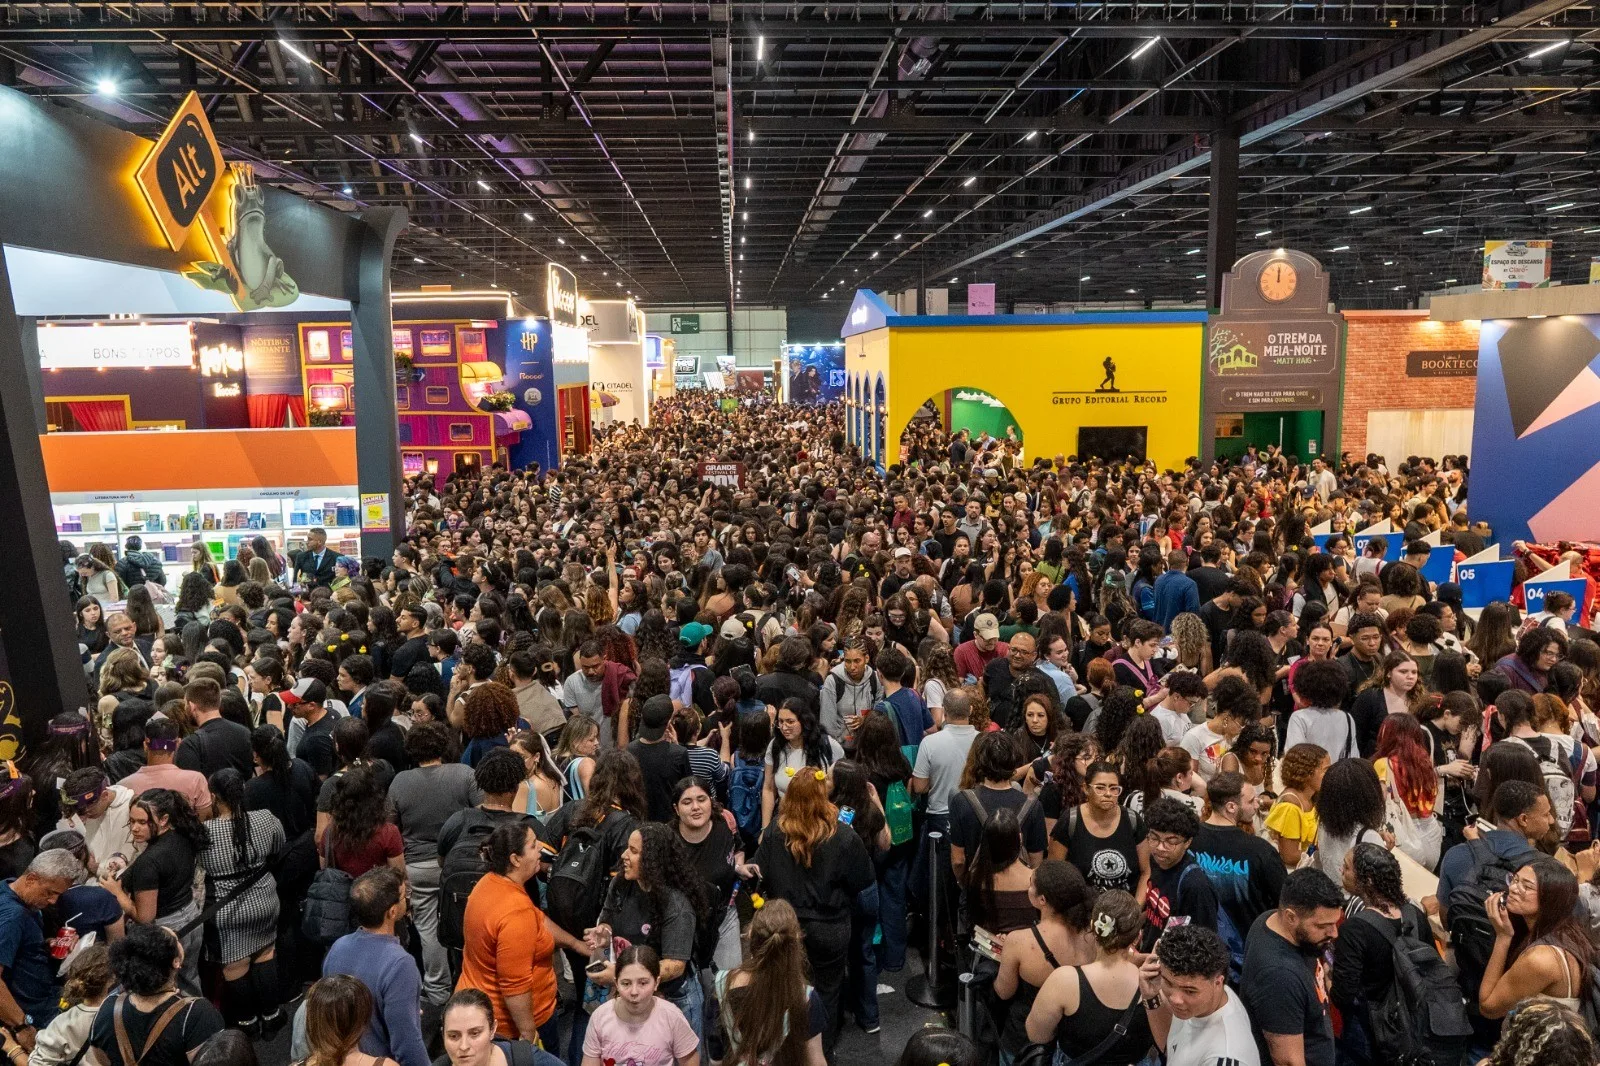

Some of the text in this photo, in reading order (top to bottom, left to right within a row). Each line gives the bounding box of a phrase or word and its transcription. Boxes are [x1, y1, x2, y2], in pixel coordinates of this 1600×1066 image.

[172, 142, 207, 210] Alt
[519, 331, 538, 353] HP
[1267, 332, 1323, 344] O TREM DA
[93, 347, 127, 360] BONS
[1263, 345, 1328, 356] MEIA-NOITE
[1276, 357, 1294, 365] MATT
[519, 372, 542, 380] Rocco
[829, 369, 846, 387] ES
[1052, 395, 1168, 405] GRUPO EDITORIAL RECORD
[1357, 539, 1370, 549] 07
[1460, 568, 1476, 581] 05
[1527, 587, 1544, 600] 04
